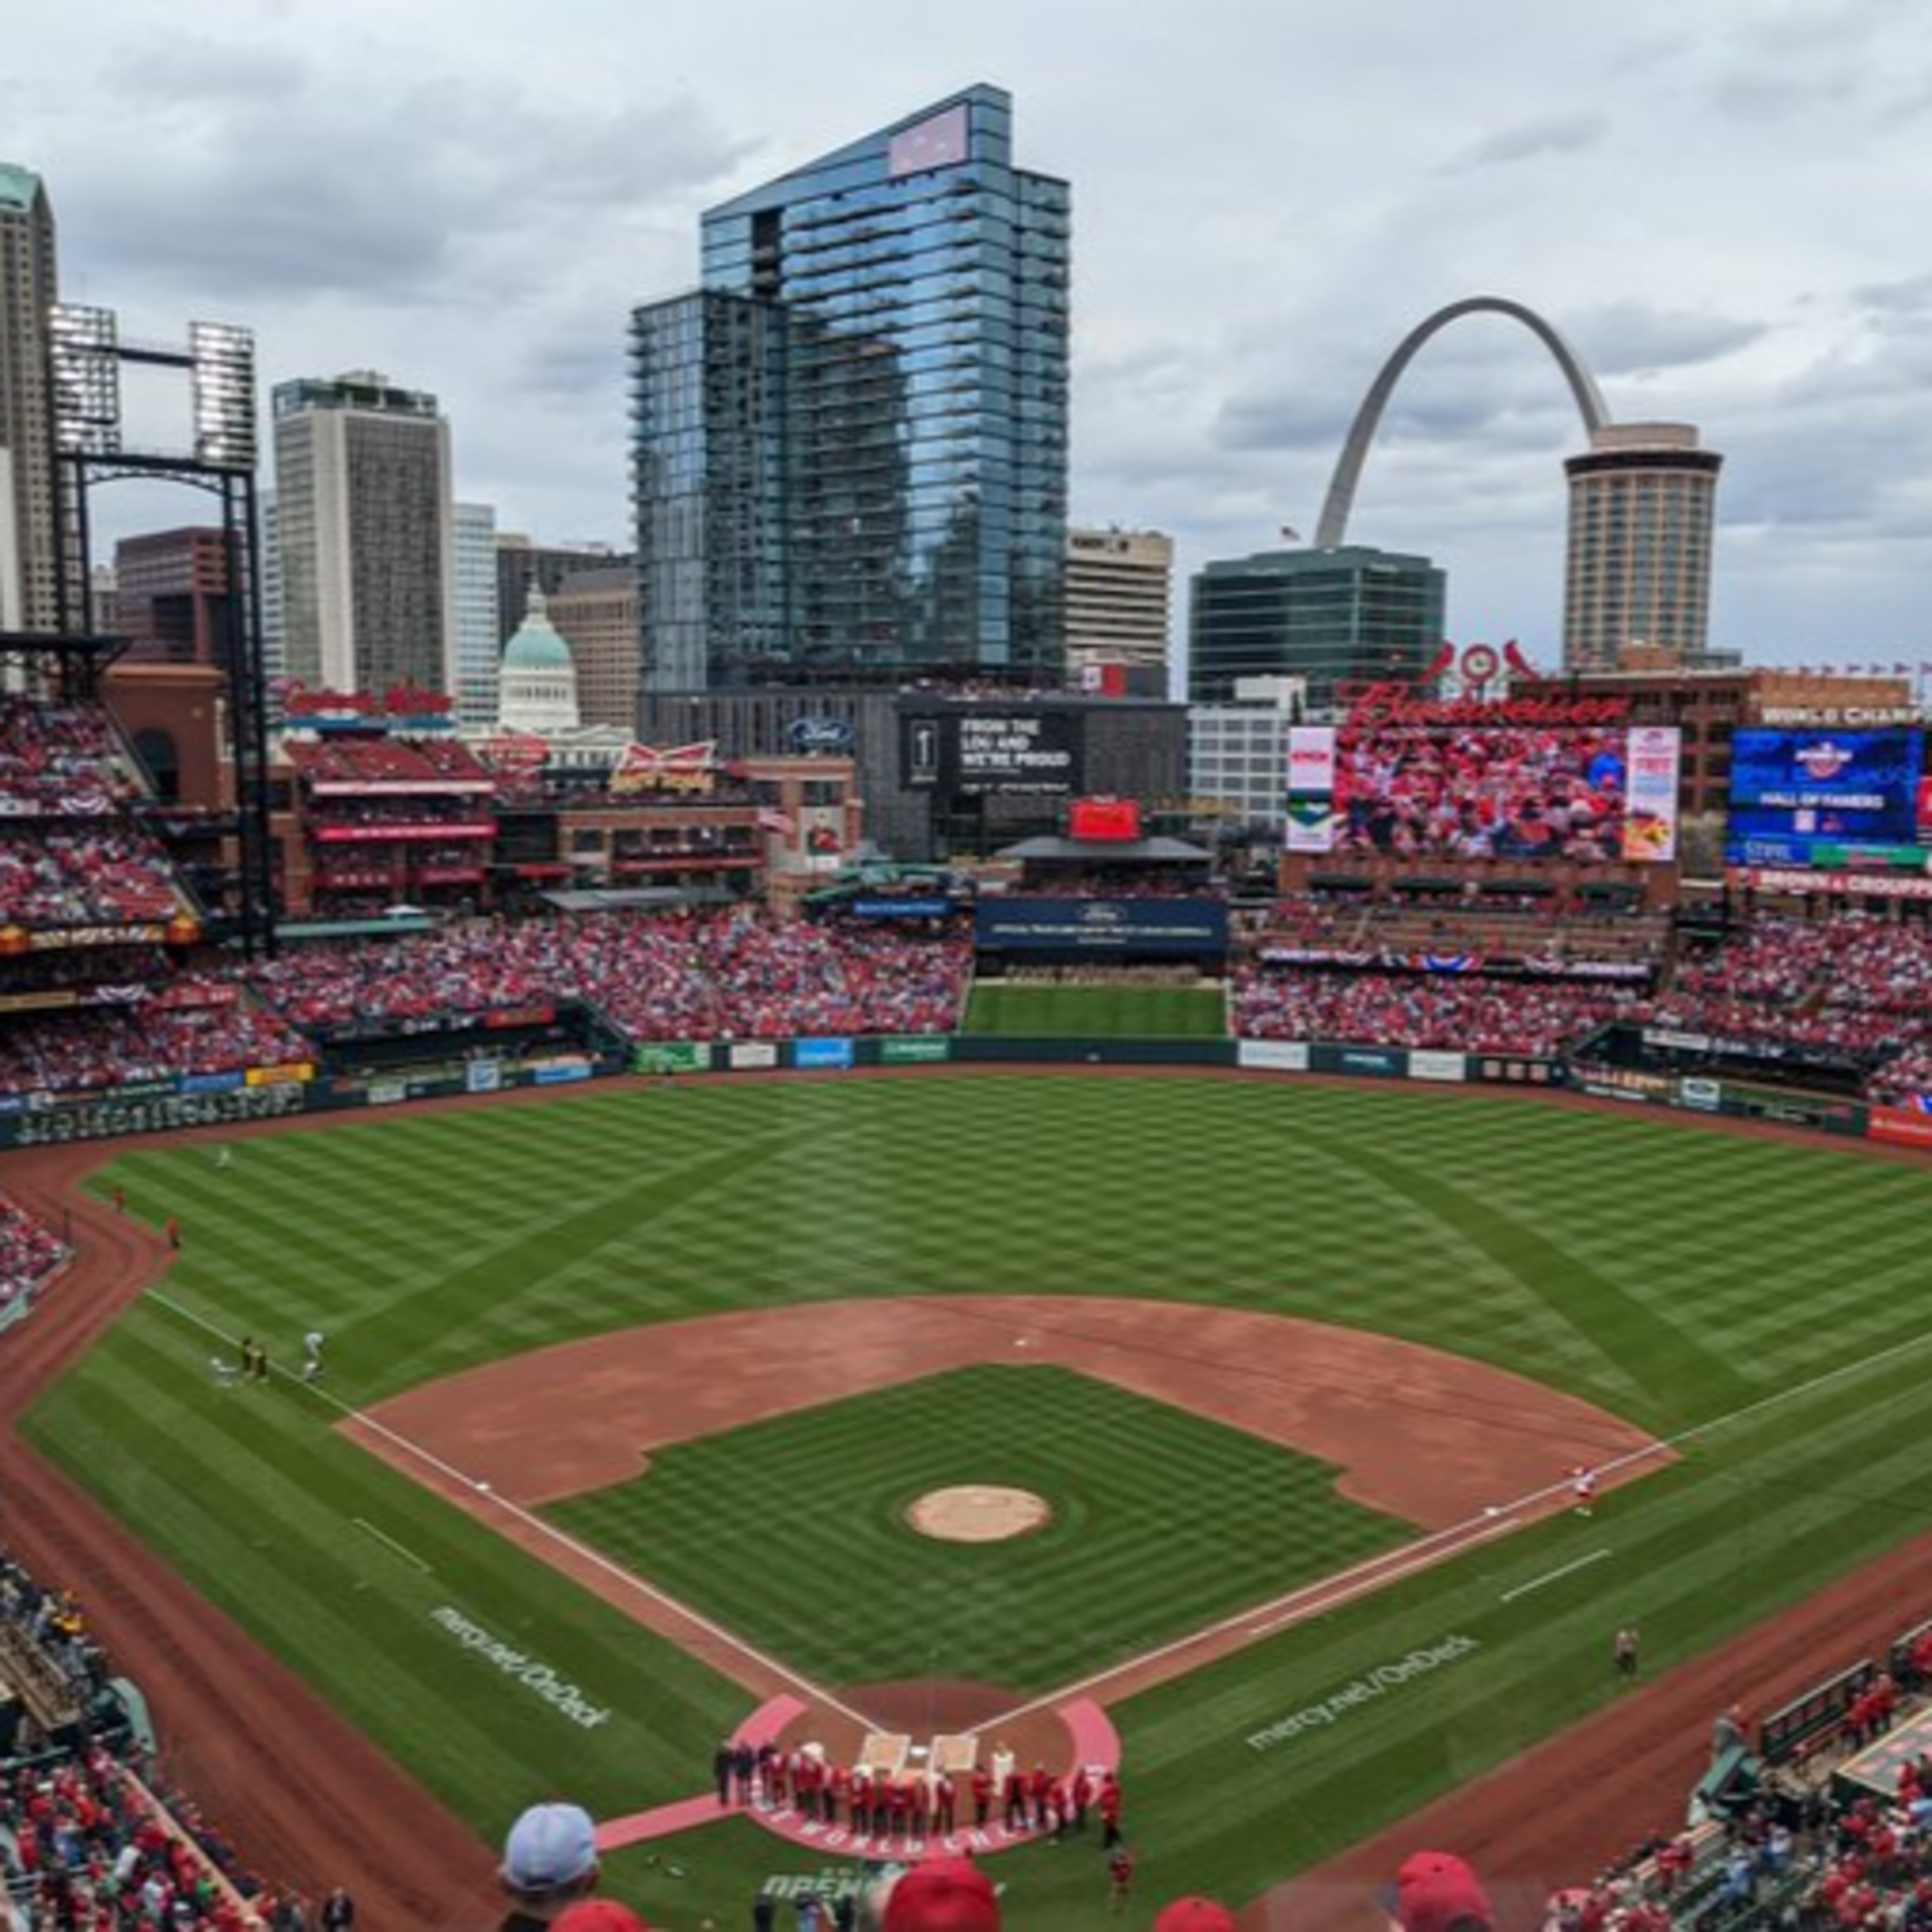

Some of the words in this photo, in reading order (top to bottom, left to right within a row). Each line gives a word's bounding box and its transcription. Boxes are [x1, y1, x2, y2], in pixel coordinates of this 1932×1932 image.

[961, 719, 1007, 733] FROM
[1012, 719, 1040, 735] THE
[997, 735, 1030, 751] AND
[1015, 752, 1071, 767] PROUD
[1246, 1635, 1481, 1750] mercy.net/OnDeck
